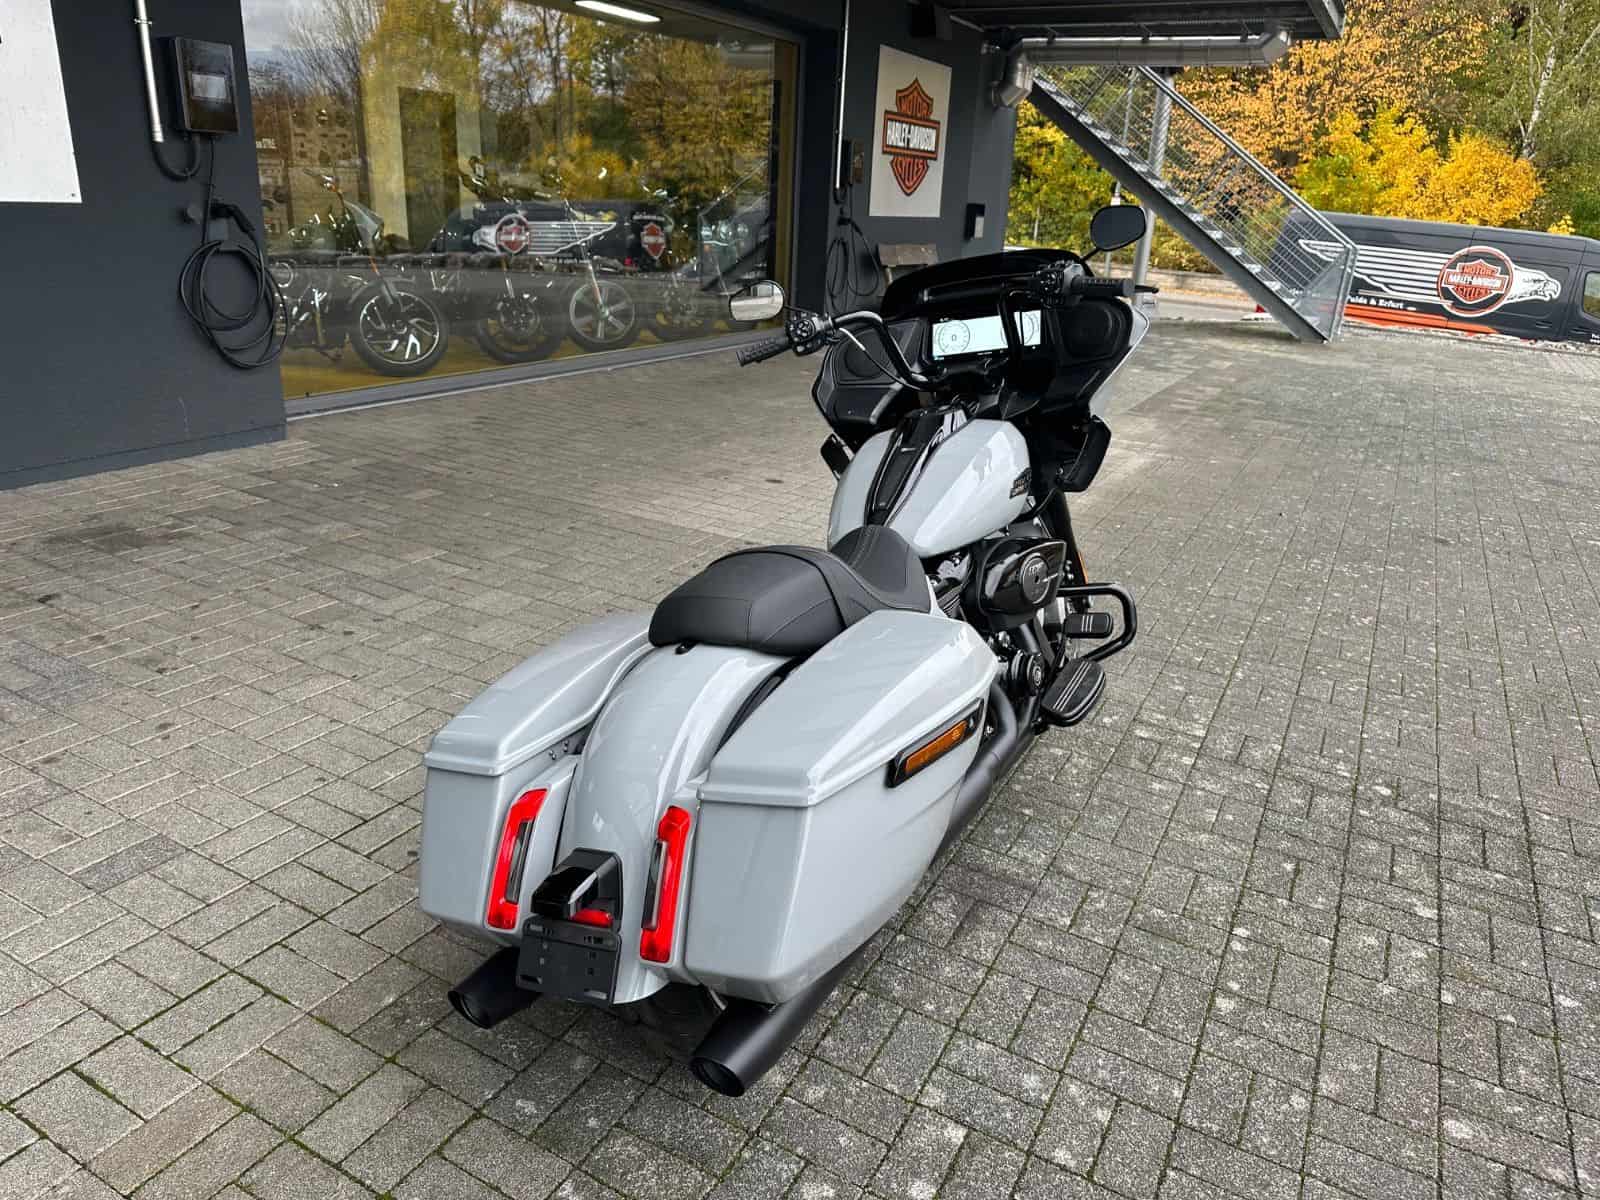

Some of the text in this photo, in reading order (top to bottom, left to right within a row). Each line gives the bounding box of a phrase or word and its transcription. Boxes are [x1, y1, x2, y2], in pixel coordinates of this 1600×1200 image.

[899, 93, 929, 119] MOTOR
[887, 120, 936, 152] HARLEY-DAVIDSON
[1463, 264, 1493, 276] MOTOR
[1448, 273, 1502, 288] HARLEY-DAVIDSON
[1379, 299, 1404, 309] Erfurt
